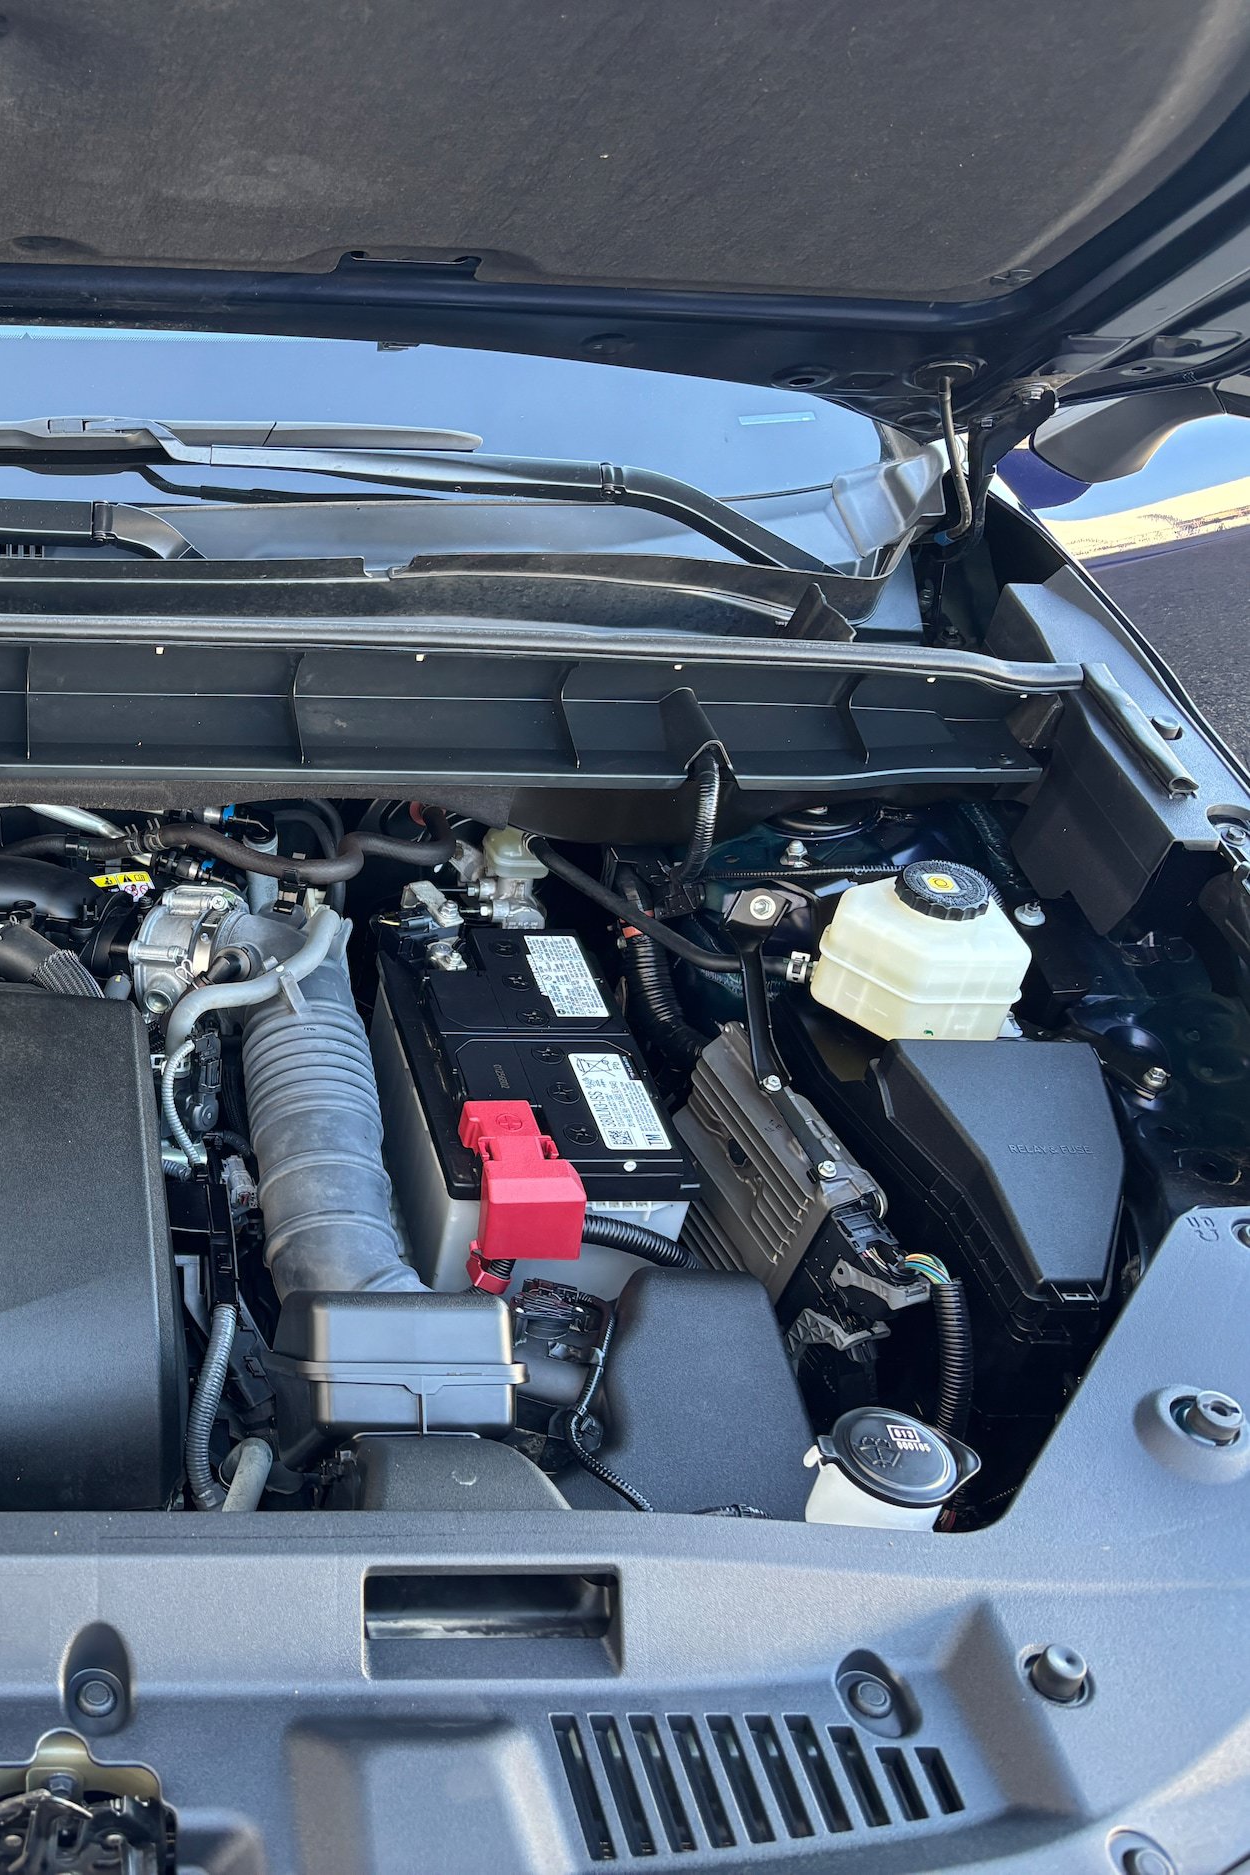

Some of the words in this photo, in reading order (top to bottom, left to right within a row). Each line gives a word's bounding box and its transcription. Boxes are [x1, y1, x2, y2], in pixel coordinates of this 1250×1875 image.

[646, 1134, 664, 1145] TM
[1008, 1144, 1048, 1154] RELAY
[1049, 1145, 1058, 1154] &
[1059, 1145, 1094, 1155] FUSE
